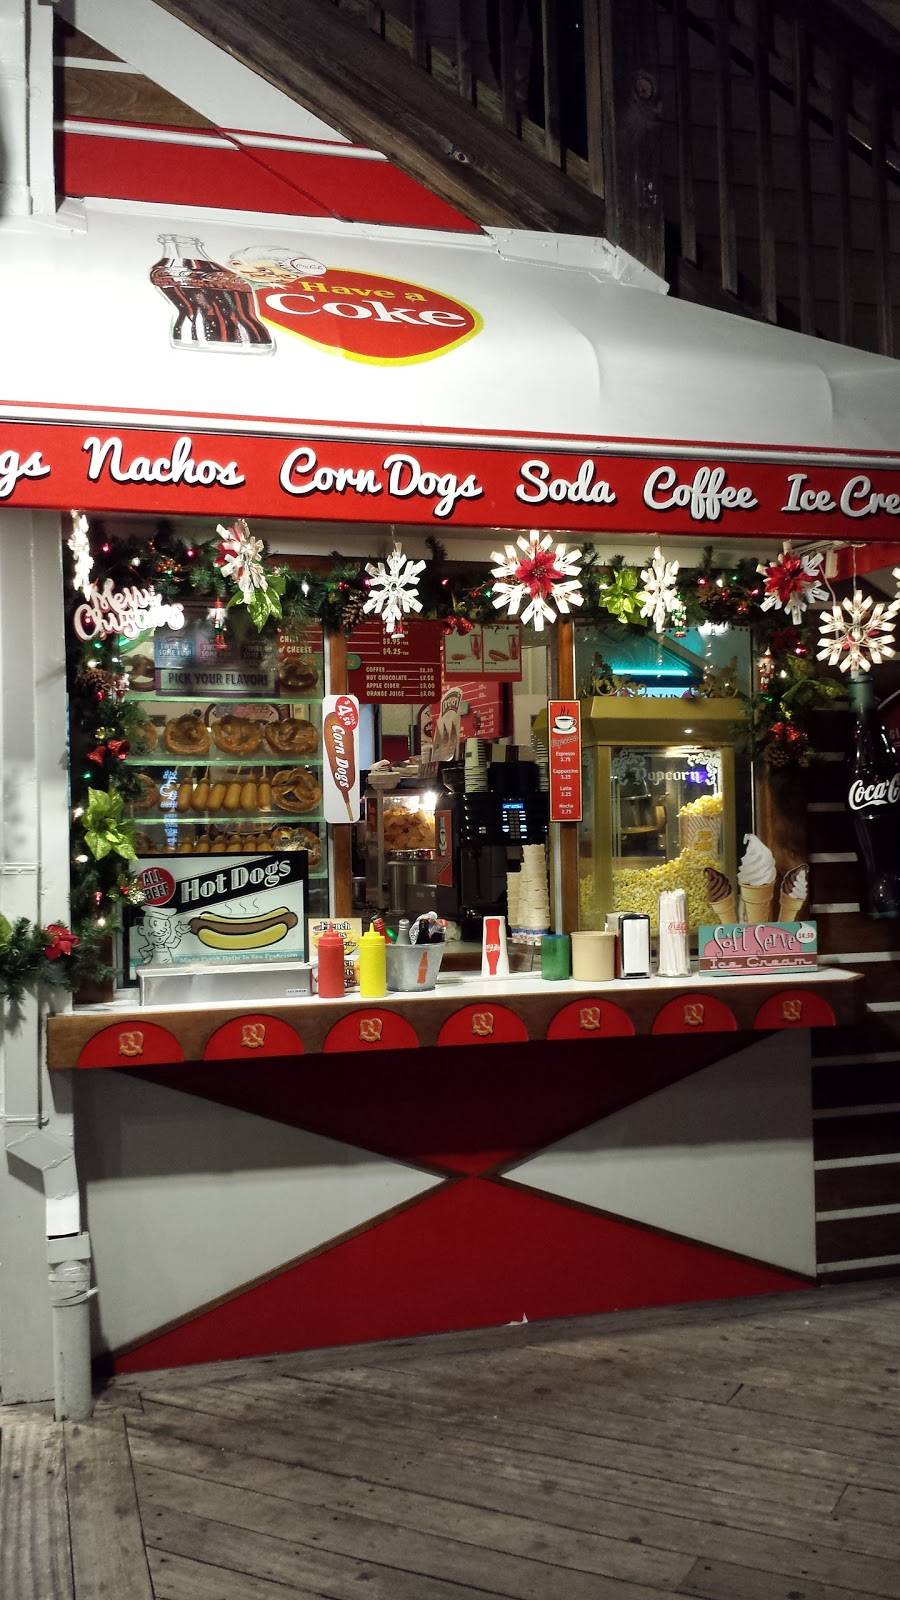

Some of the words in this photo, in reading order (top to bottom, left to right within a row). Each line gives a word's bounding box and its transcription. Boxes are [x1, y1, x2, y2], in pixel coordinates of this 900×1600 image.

[299, 281, 396, 299] Have
[404, 291, 428, 302] a
[265, 293, 467, 328] Coke
[82, 436, 245, 488] Nachos
[280, 446, 383, 495] Corn
[383, 454, 483, 517] Dogs
[515, 459, 617, 503] Soda
[643, 465, 759, 520] Coffee
[780, 472, 837, 513] Ice
[168, 672, 190, 685] PICK
[194, 673, 224, 686] YOUR
[225, 673, 269, 686] FLAVOR!
[331, 724, 346, 755] Corn
[334, 756, 350, 788] Dogs
[633, 767, 704, 786] Popcorn
[143, 869, 161, 887] ALL
[180, 873, 228, 904] Hot
[230, 859, 292, 888] Dogs
[144, 885, 169, 902] BEEF
[713, 926, 748, 957] Soft
[753, 924, 797, 956] Serve
[710, 958, 743, 969] Ice
[746, 956, 813, 968] Cream
